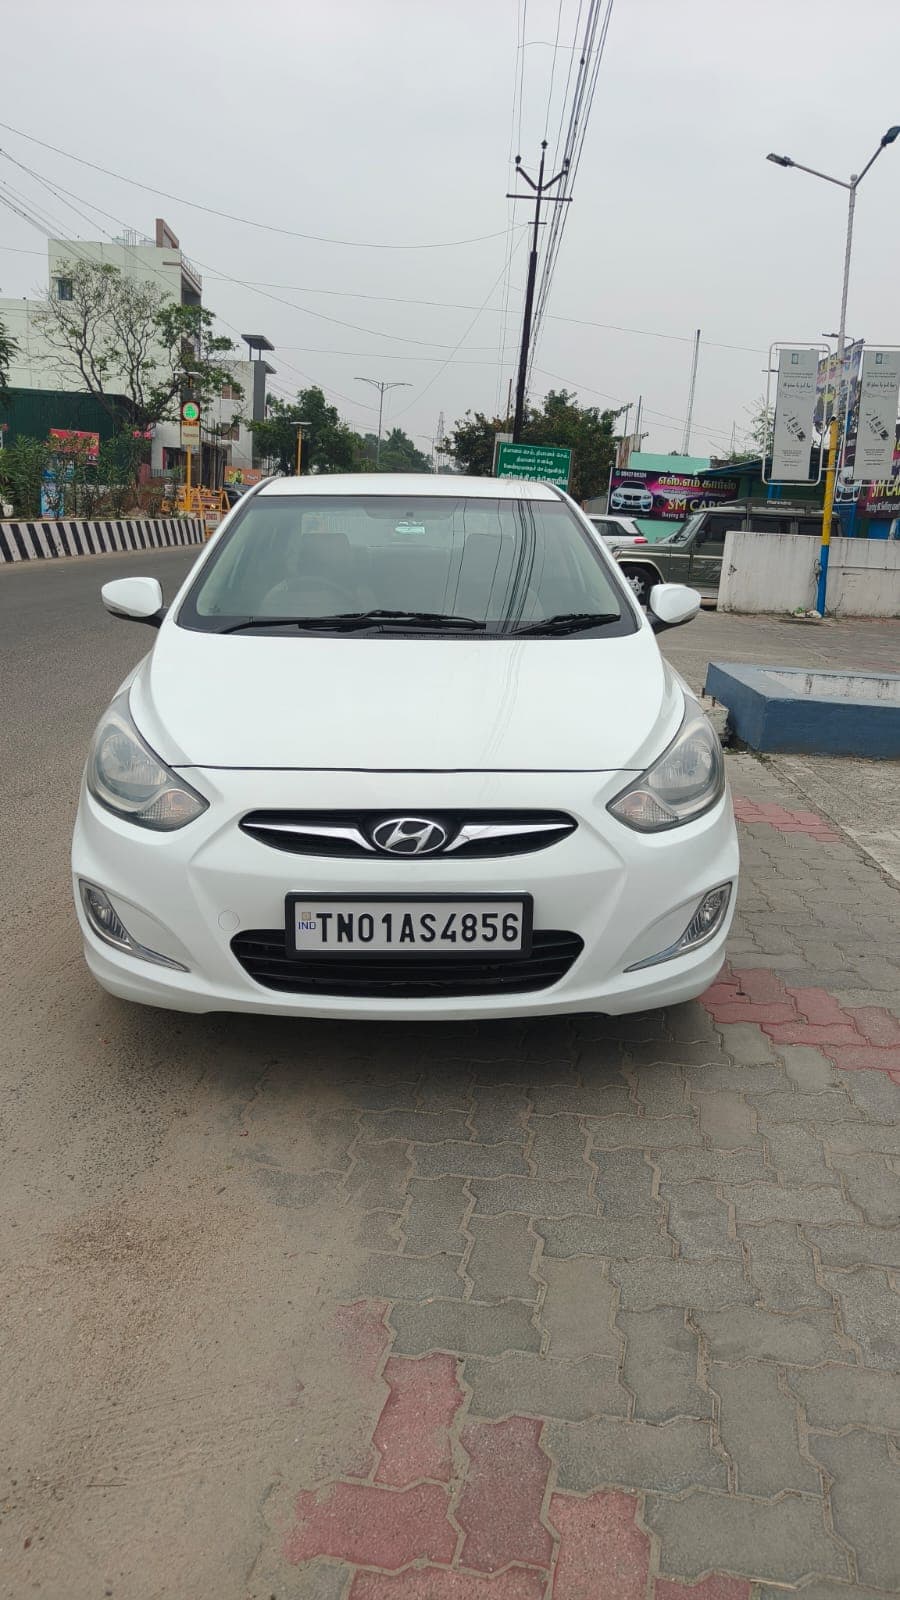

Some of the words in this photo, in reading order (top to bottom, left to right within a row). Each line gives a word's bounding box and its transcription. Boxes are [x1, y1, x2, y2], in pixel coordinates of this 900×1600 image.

[668, 498, 687, 511] SM
[298, 921, 316, 930] IND
[316, 913, 519, 943] TN01AS4856
